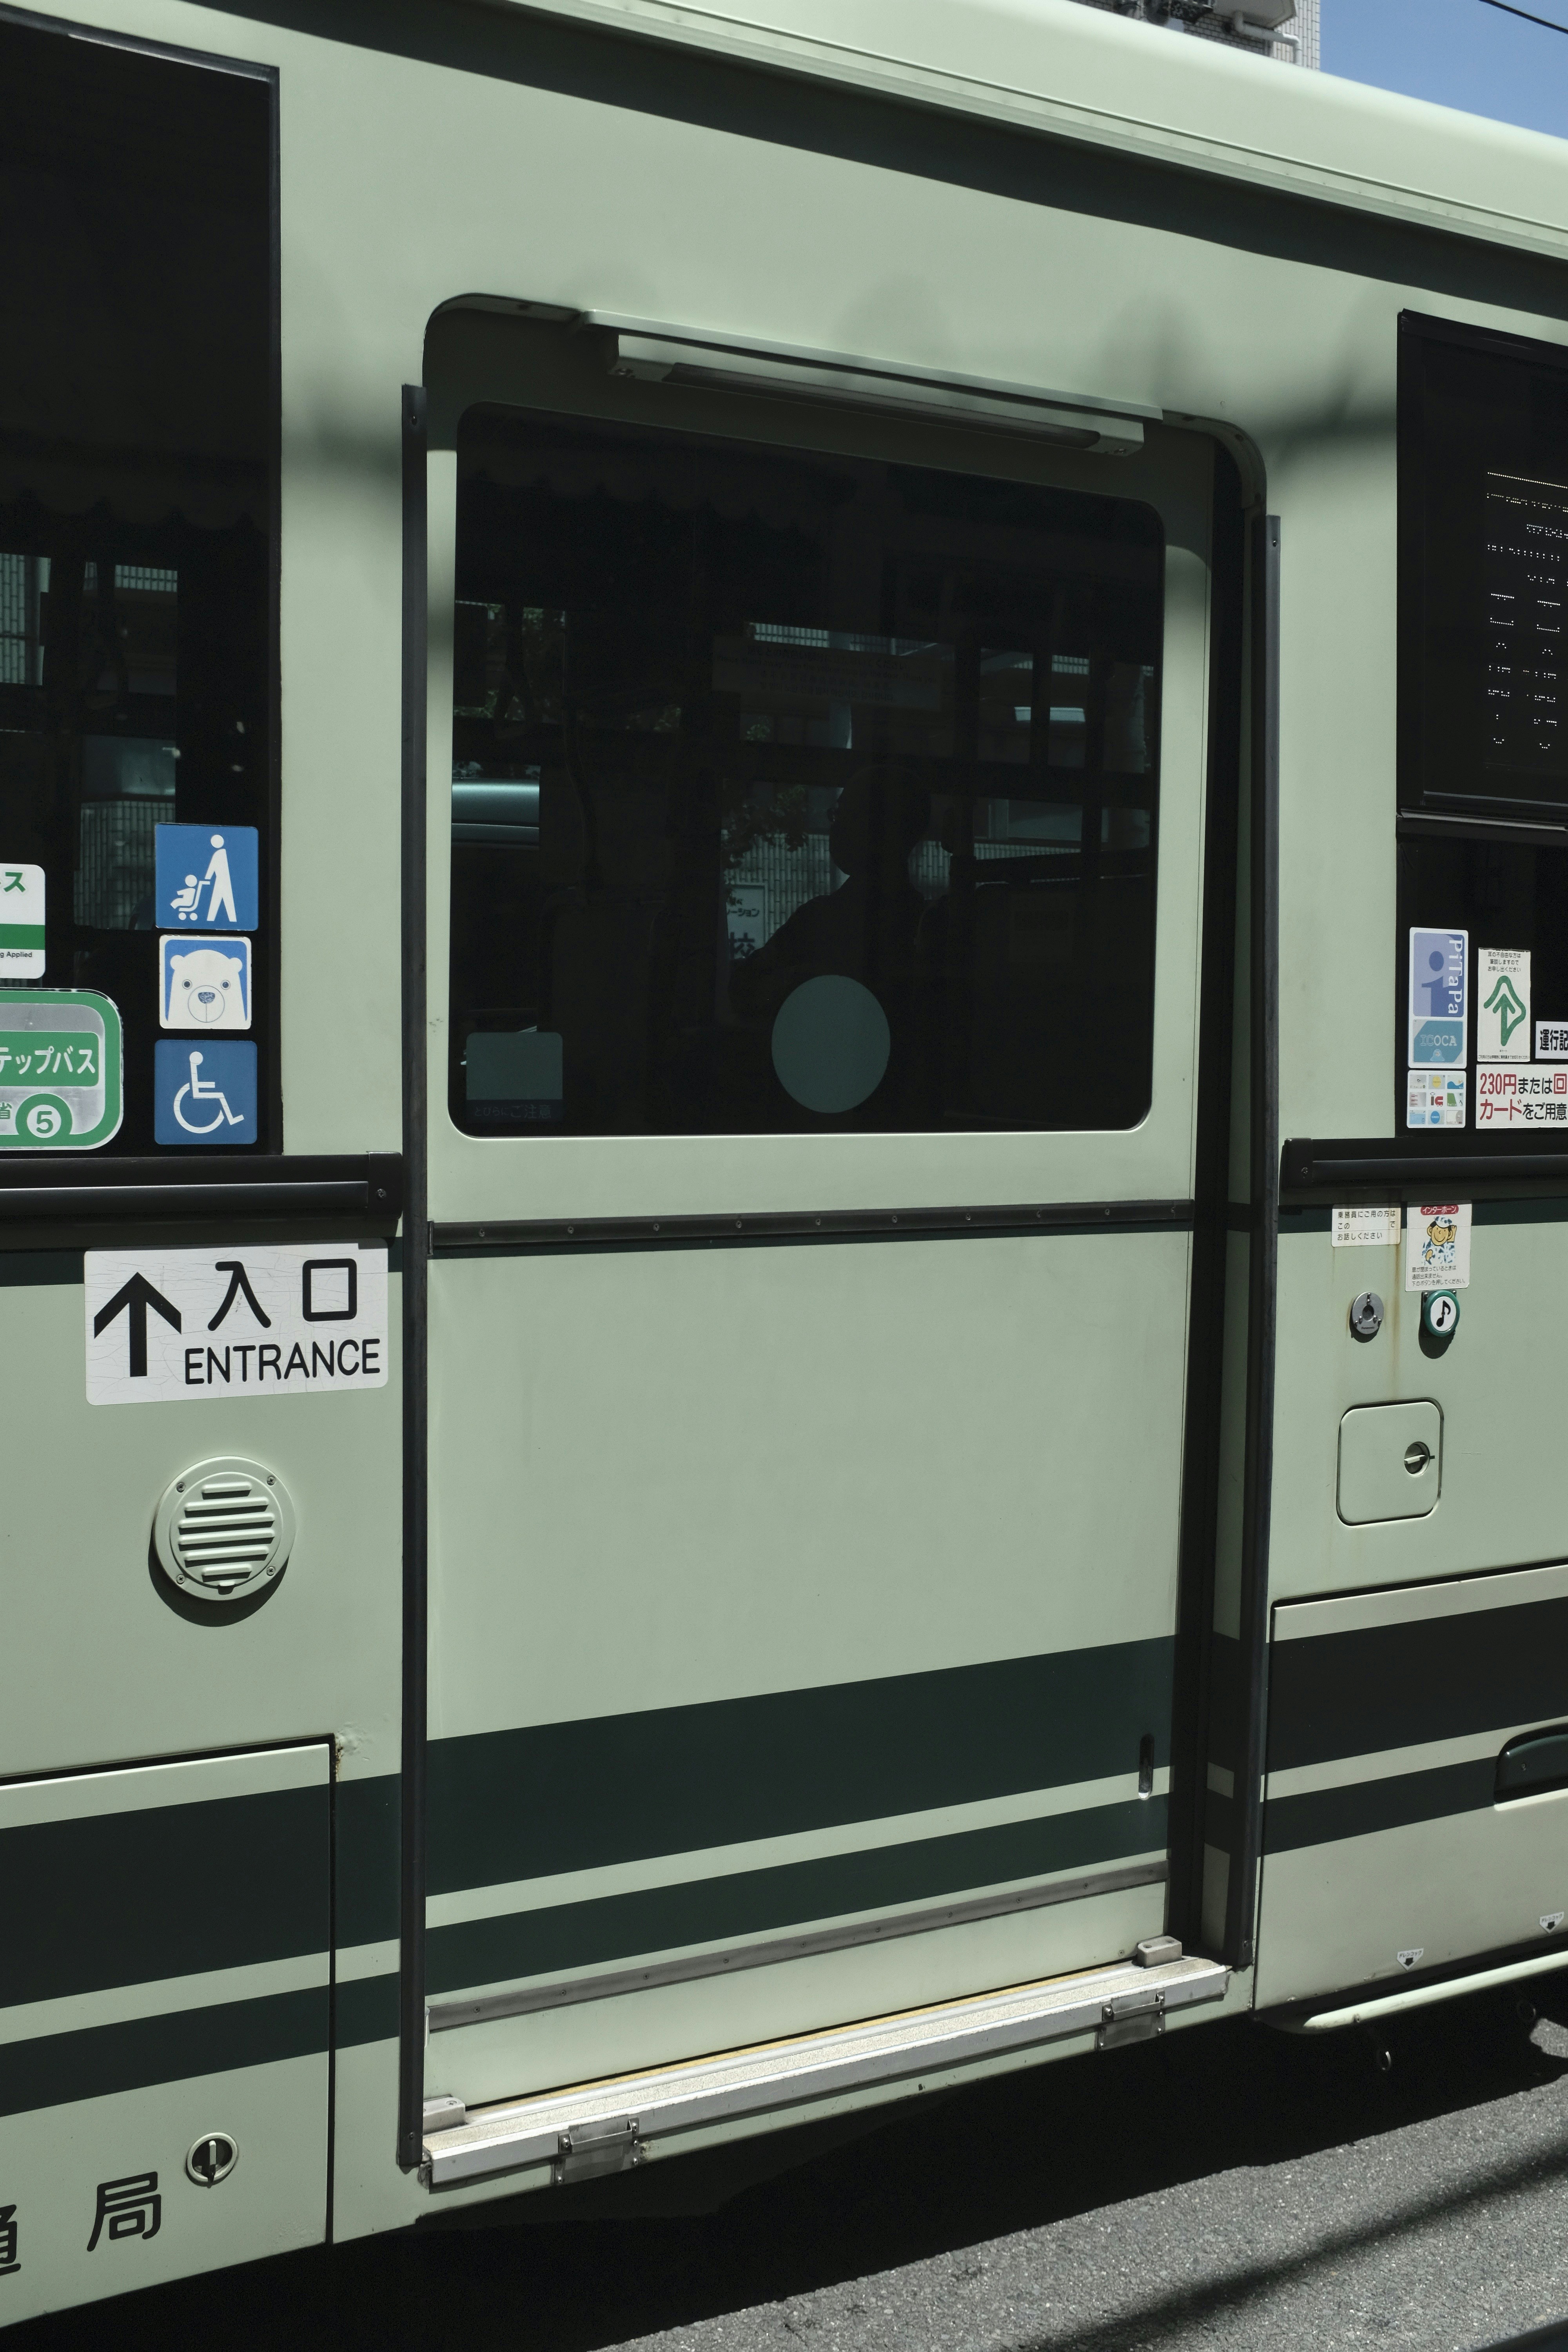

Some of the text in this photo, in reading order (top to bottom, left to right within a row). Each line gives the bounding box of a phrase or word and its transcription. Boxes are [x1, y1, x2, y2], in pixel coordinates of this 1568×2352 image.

[0, 871, 25, 893] ス
[1448, 938, 1463, 1014] PiTaPa
[1420, 1035, 1457, 1046] ICOCA
[1540, 1029, 1568, 1051] 運行記
[0, 1045, 95, 1074] テップバス
[1480, 1073, 1568, 1095] 230円または回
[1480, 1099, 1568, 1121] カードをご用意
[36, 1111, 53, 1134] 5
[1338, 1210, 1396, 1219] 乗務員にご用の方は
[1338, 1232, 1382, 1241] お話しください
[207, 1258, 357, 1331] 入口
[185, 1339, 380, 1385] ENTRANCE
